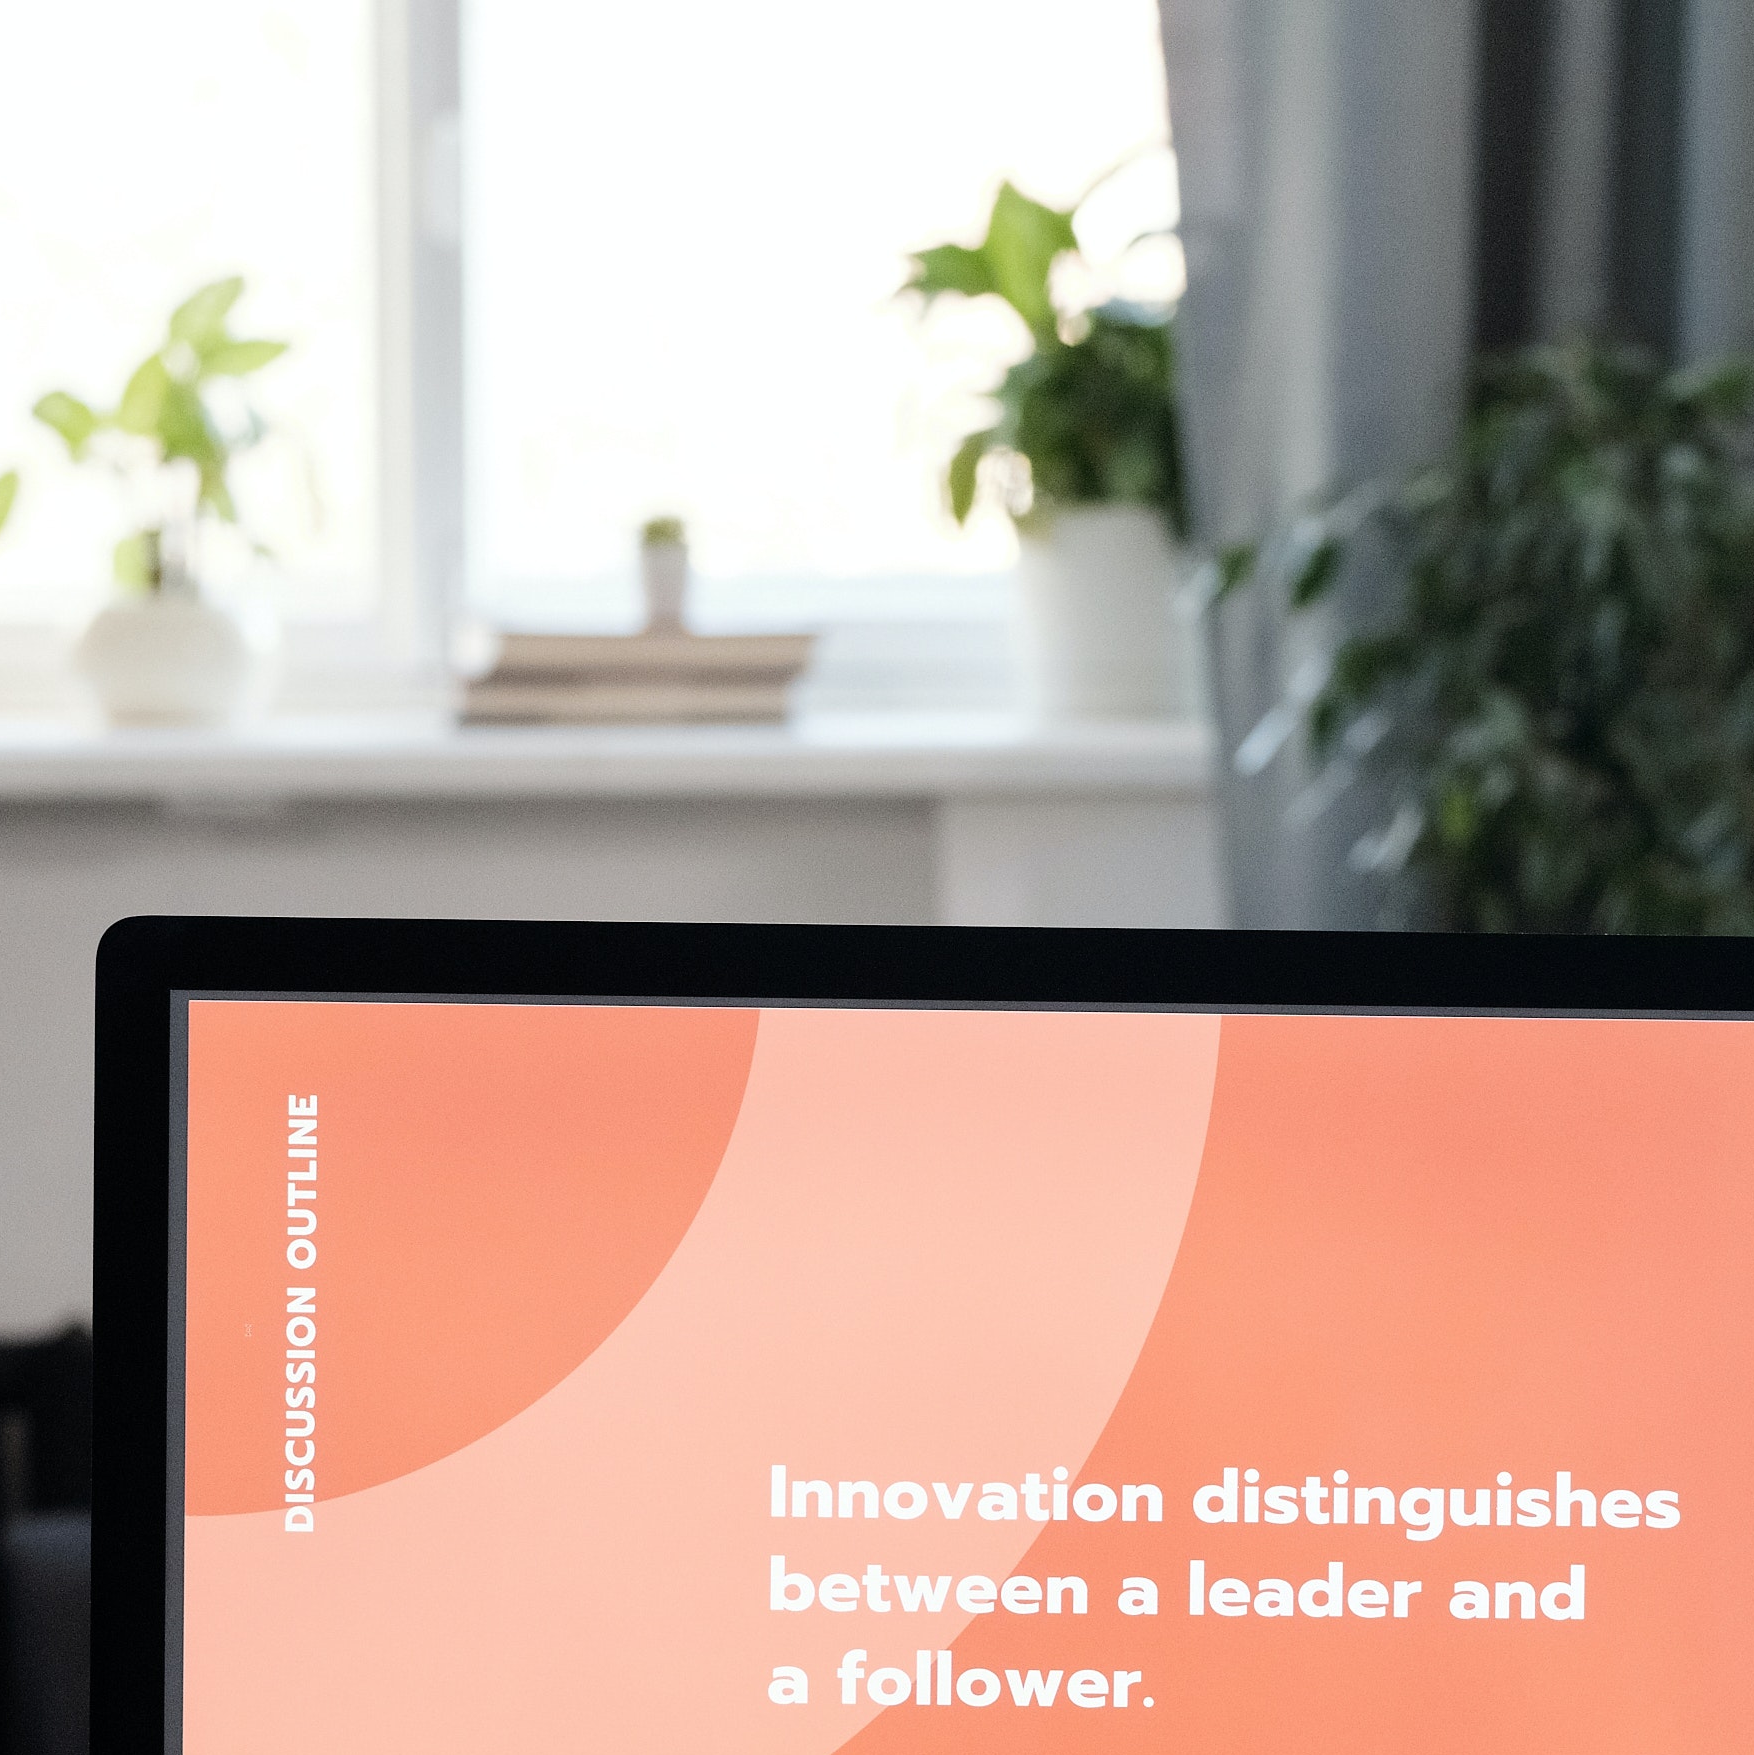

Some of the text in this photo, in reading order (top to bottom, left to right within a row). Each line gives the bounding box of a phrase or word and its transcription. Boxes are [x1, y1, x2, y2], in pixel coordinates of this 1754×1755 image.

[285, 1095, 319, 1534] DISCUSSION OUTLINE
[770, 1464, 1683, 1544] Innovation distinguishes
[769, 1554, 1587, 1623] between a leader and
[767, 1648, 1157, 1710] a follower.
